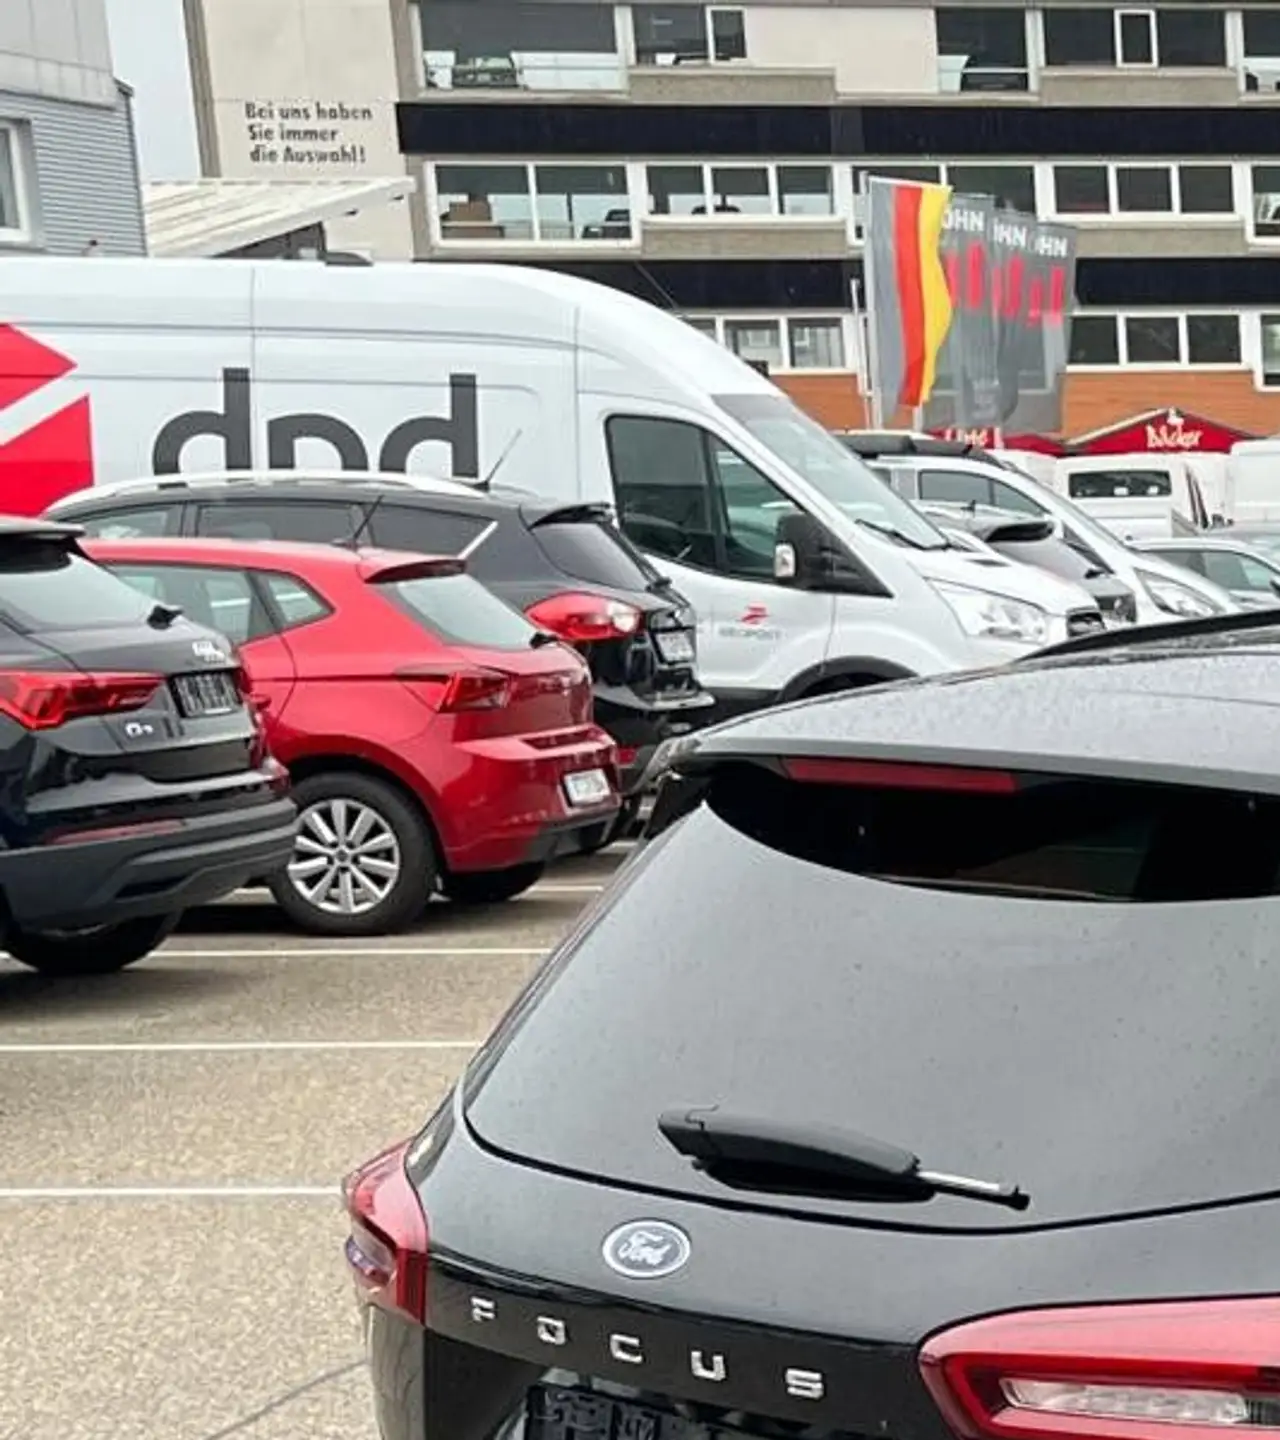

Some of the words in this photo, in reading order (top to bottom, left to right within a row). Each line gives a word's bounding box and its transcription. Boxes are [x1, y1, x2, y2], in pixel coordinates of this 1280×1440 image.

[245, 101, 275, 119] Bei
[280, 106, 311, 120] uns
[316, 101, 372, 120] haben
[248, 124, 274, 140] Sie
[280, 122, 338, 140] immer
[250, 144, 278, 162] die
[283, 145, 366, 162] Auswahl!
[617, 1230, 672, 1266] Ford
[471, 1296, 824, 1399] FOCUS
